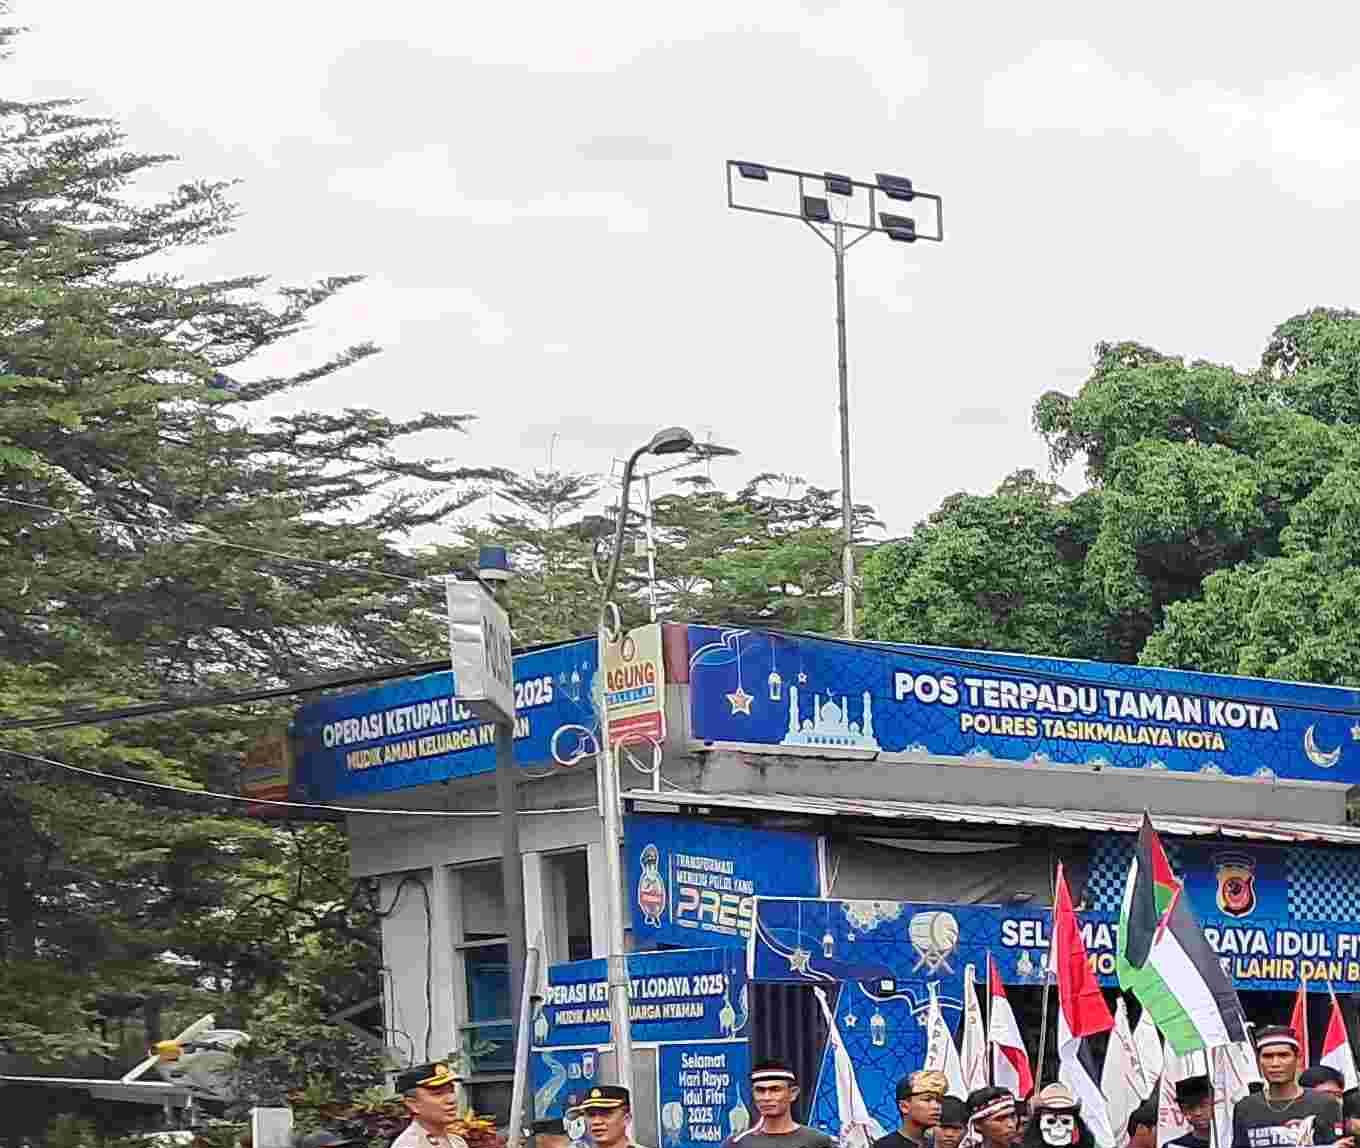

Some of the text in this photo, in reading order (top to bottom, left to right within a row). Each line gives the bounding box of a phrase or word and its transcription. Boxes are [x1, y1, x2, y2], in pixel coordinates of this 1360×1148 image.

[607, 662, 655, 691] AGUNG
[322, 715, 384, 748] OPERASI
[384, 700, 450, 736] KETUPAT
[514, 676, 552, 709] 2025
[895, 671, 1279, 732] POS TERPADU TAMAN KOTA
[960, 713, 1226, 752] POLRES TASIKMALAYA KOTA
[346, 746, 383, 771] MUDIK
[383, 740, 418, 765] AMAN
[418, 731, 478, 759] KELUARGA
[677, 888, 754, 929] PRES
[1204, 928, 1269, 954] RAYA
[1276, 931, 1331, 958] IDUL
[1236, 957, 1294, 979] LAHIR
[1300, 959, 1342, 981] DAN
[641, 978, 690, 1000] LODAYA
[691, 974, 724, 996] 2025
[662, 1002, 704, 1019] NYAMAN
[682, 1052, 725, 1069] Selamat
[679, 1071, 730, 1090] Hari Raya
[682, 1088, 726, 1105] Idul Fitri
[688, 1107, 713, 1122] 2025
